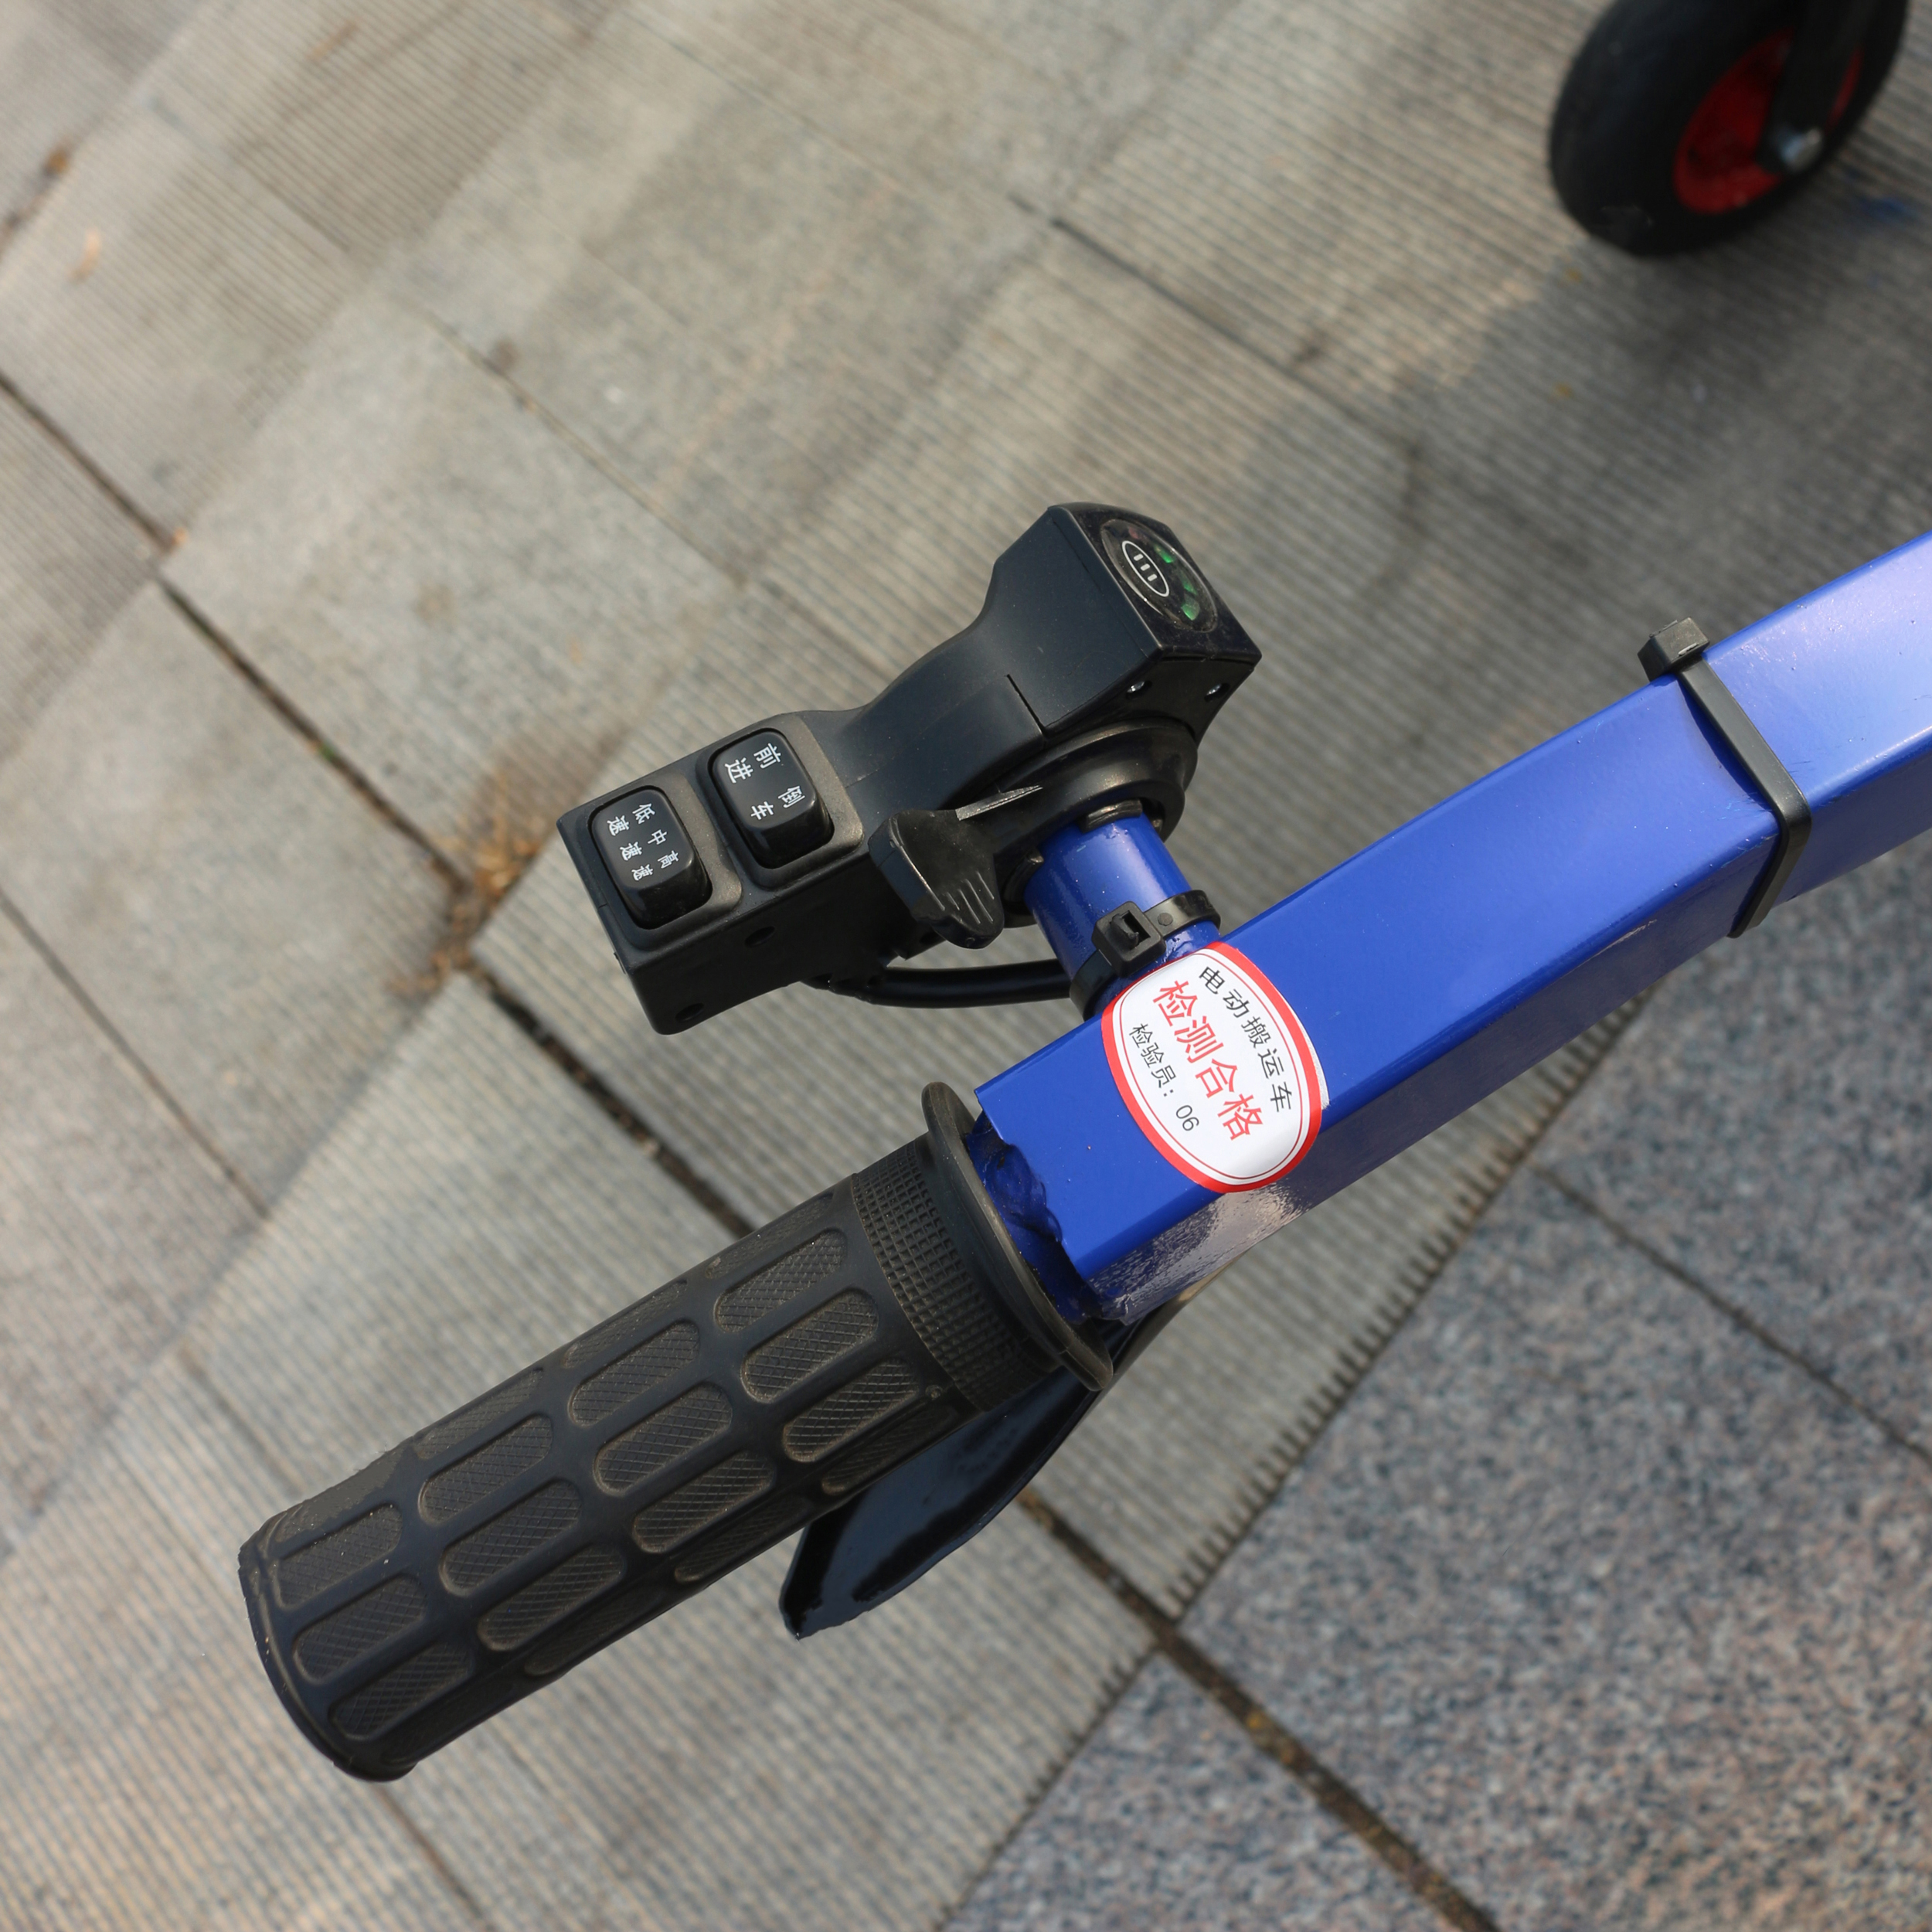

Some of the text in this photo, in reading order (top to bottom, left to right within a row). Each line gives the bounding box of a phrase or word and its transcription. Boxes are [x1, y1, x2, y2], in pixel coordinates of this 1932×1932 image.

[724, 743, 781, 784] 前进
[607, 803, 655, 836] 低速
[750, 785, 805, 821] 倒车
[619, 829, 668, 862] 中速
[631, 850, 679, 881] 高速
[1199, 966, 1293, 1113] 电动搬运车
[1152, 980, 1263, 1141] 检测合格
[1175, 1104, 1199, 1131] 06
